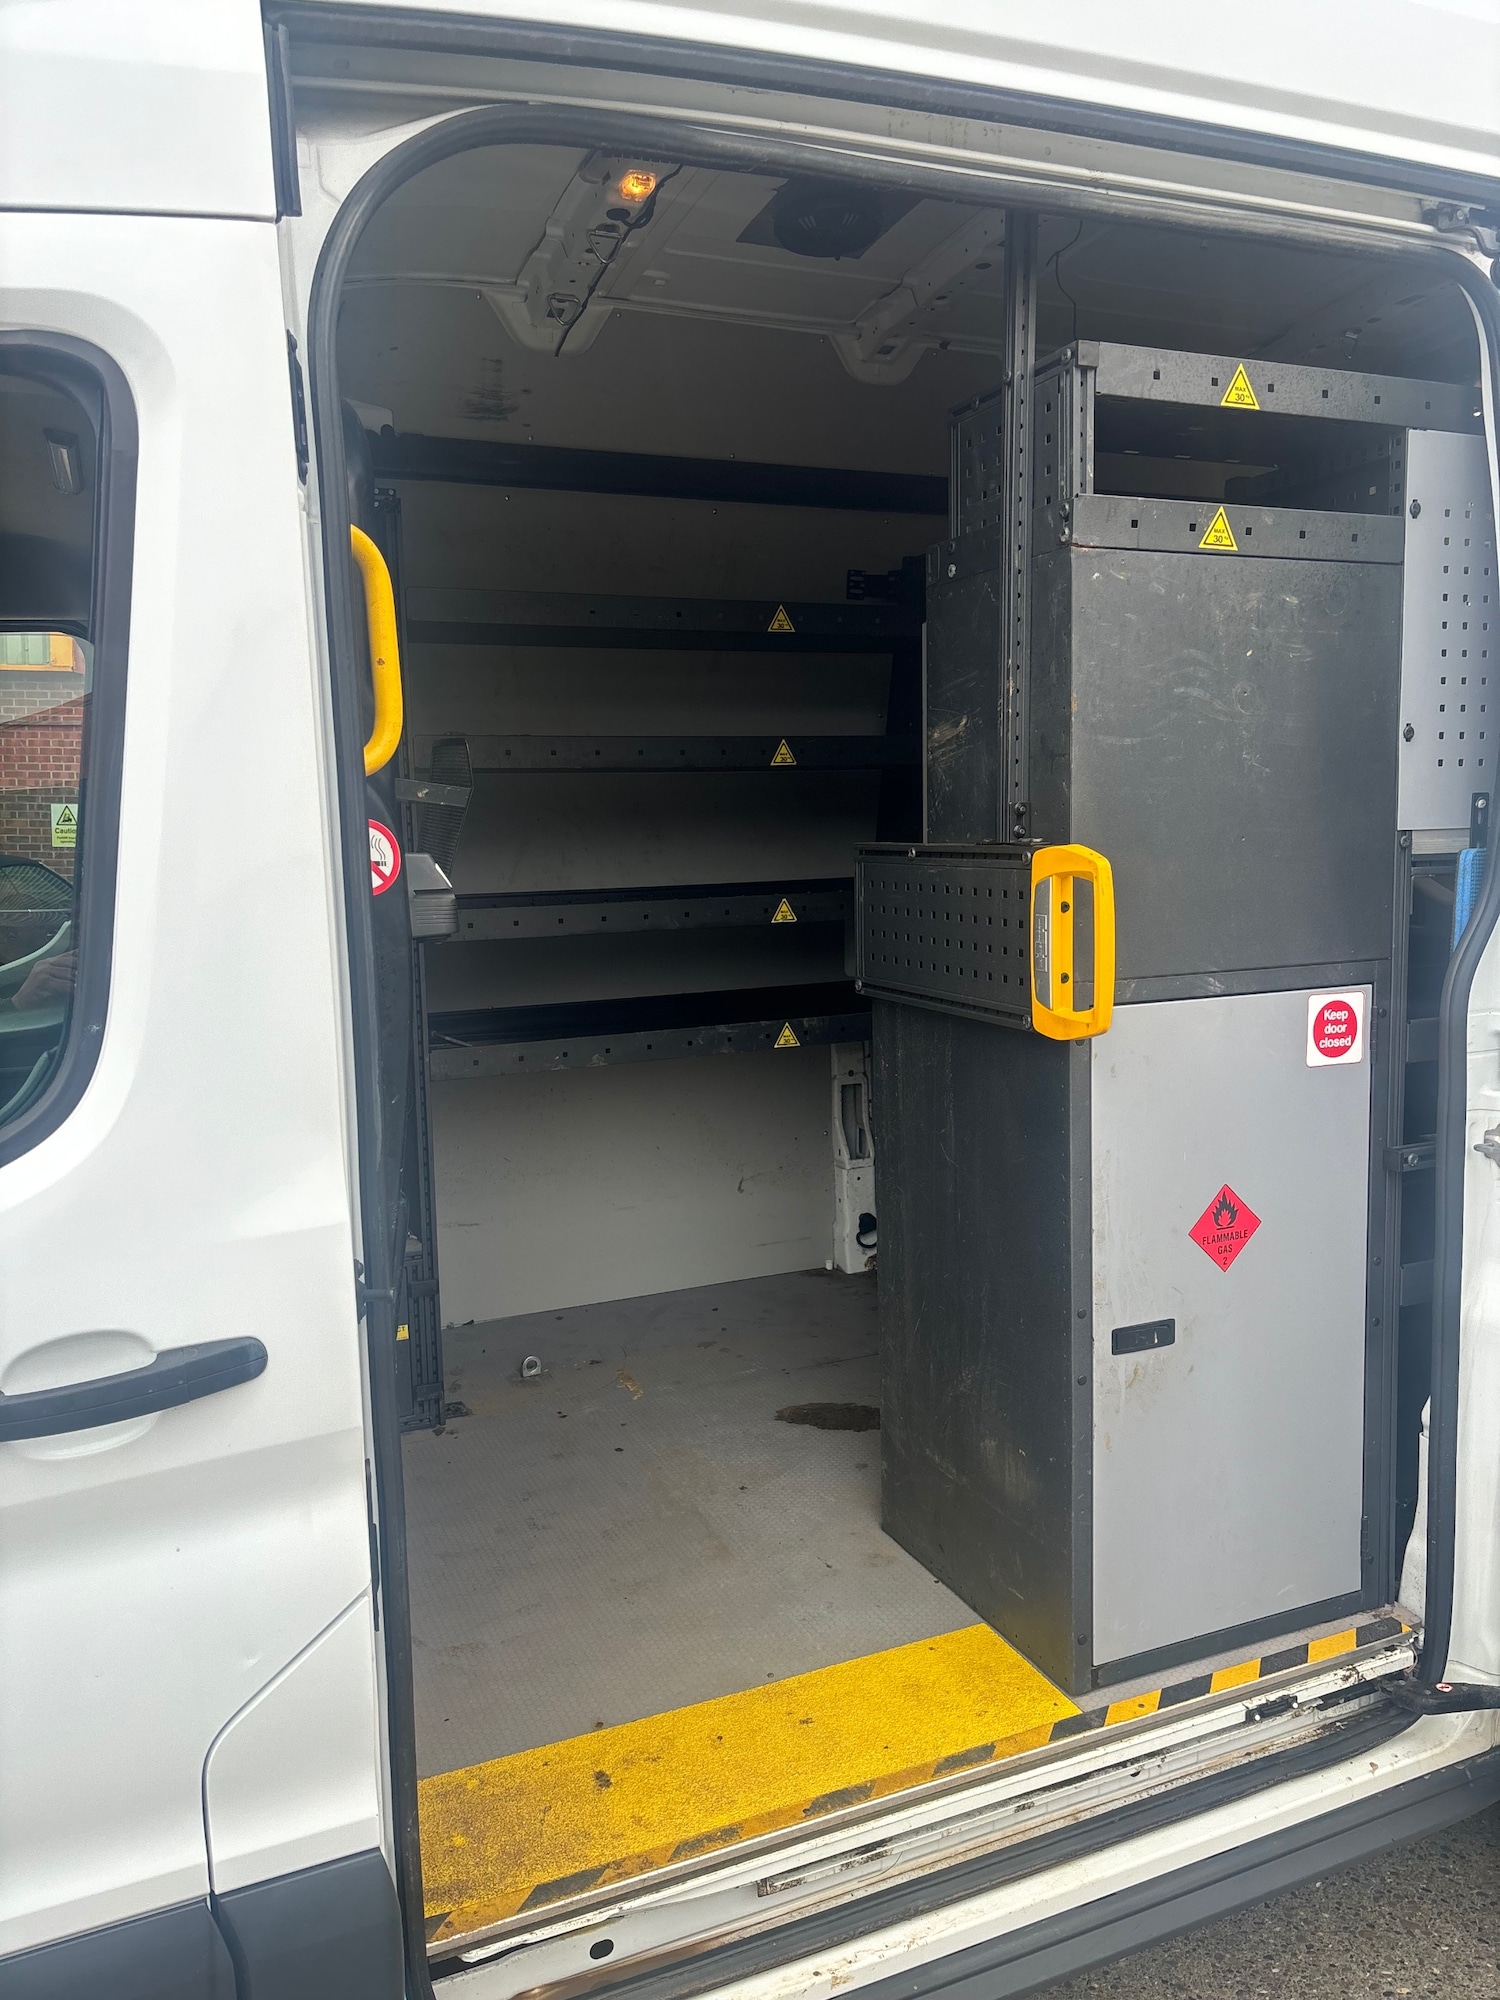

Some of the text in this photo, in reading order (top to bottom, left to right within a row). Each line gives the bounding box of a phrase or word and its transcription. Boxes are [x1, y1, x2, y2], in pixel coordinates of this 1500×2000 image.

[1323, 1008, 1349, 1022] Keep
[1324, 1022, 1348, 1034] door
[1319, 1035, 1352, 1048] closed
[1202, 1229, 1249, 1246] FLAMMABLE
[1217, 1243, 1233, 1255] GAS
[1222, 1256, 1228, 1265] 2
